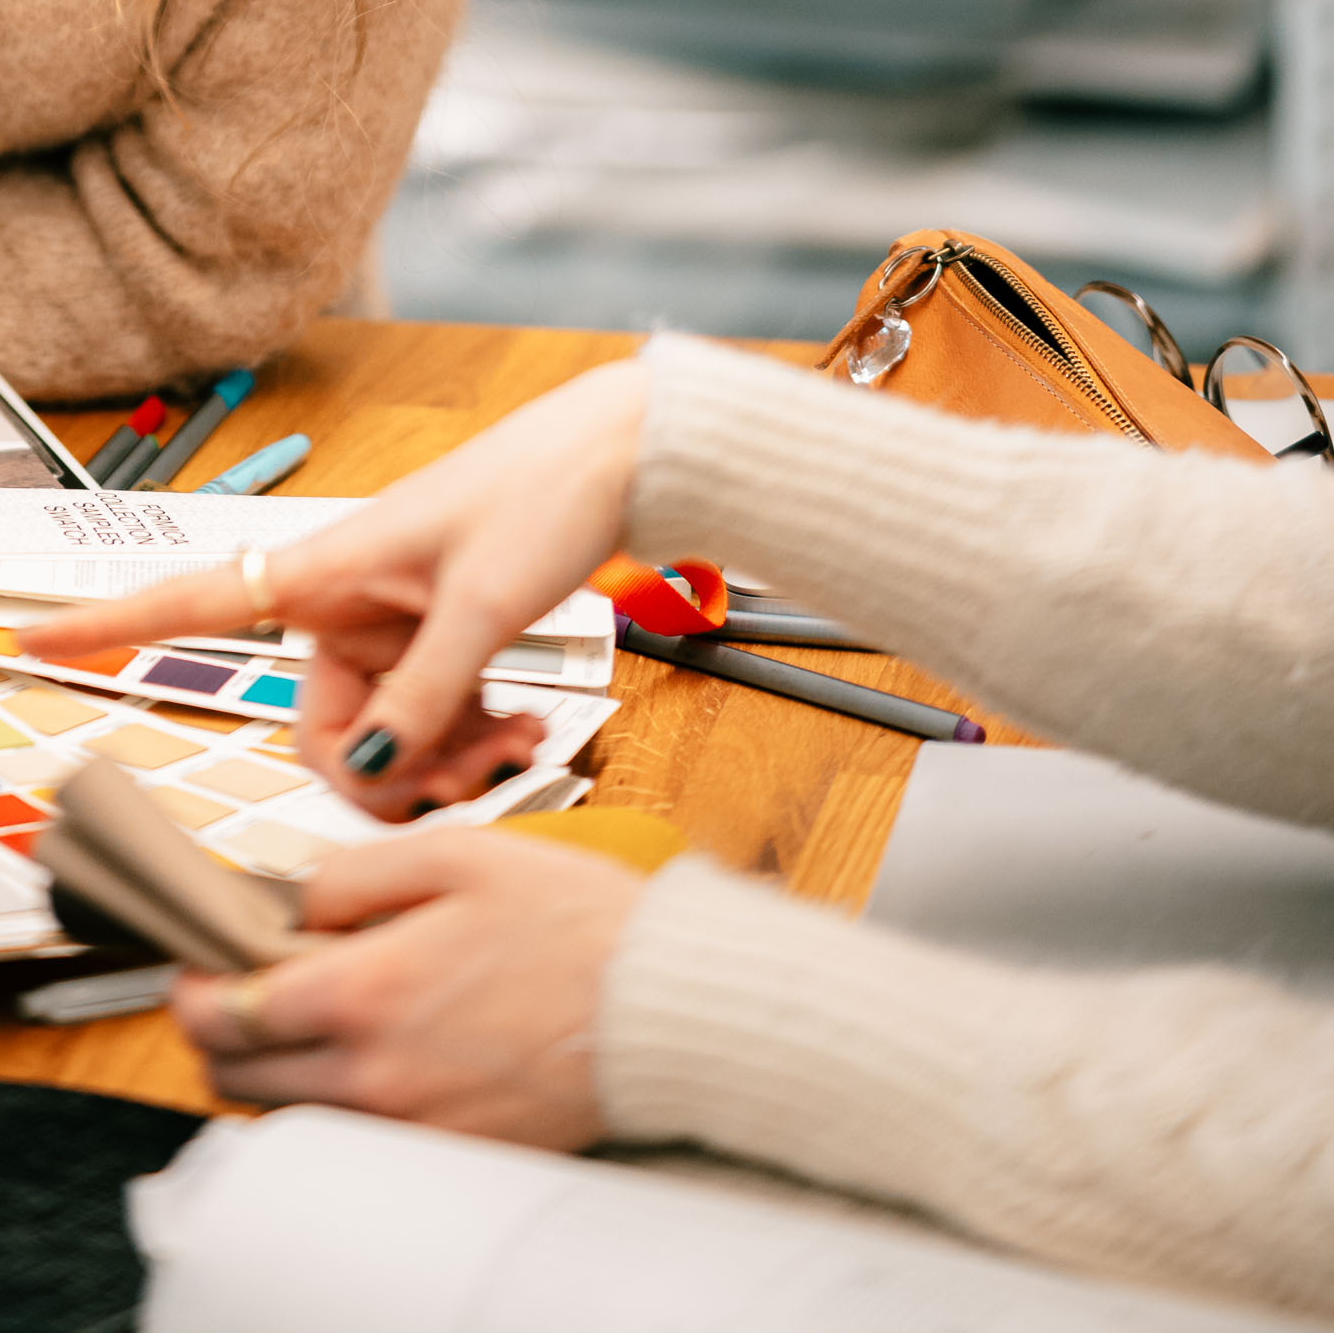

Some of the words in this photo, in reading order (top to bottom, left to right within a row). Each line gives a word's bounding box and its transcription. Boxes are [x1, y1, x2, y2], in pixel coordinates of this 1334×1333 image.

[43, 505, 92, 546] SWATCH
[72, 501, 125, 546] SAMPLES
[94, 492, 158, 545] COLLECTION
[137, 504, 190, 546] FORMICA
